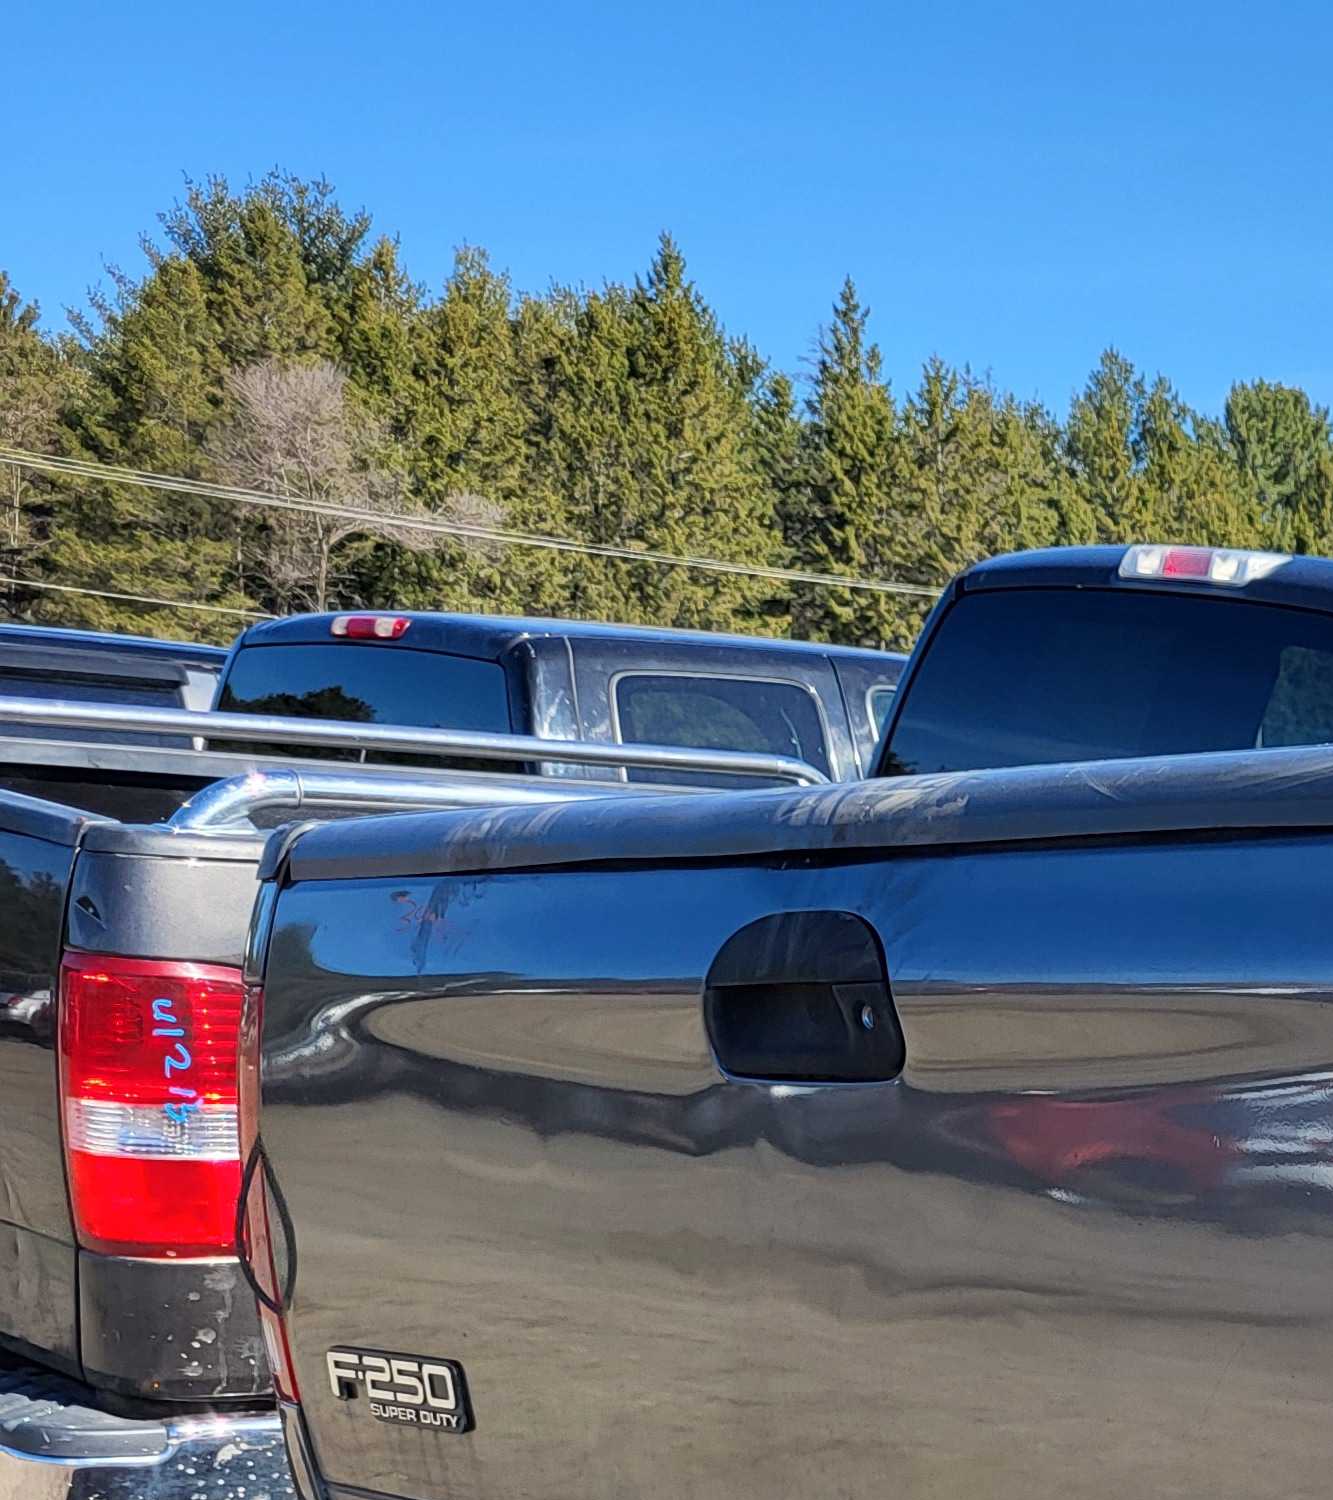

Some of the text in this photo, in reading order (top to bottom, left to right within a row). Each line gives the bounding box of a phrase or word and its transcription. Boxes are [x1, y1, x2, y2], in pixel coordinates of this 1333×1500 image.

[325, 1351, 456, 1410] F-250
[369, 1402, 459, 1428] SUPER DUTY
